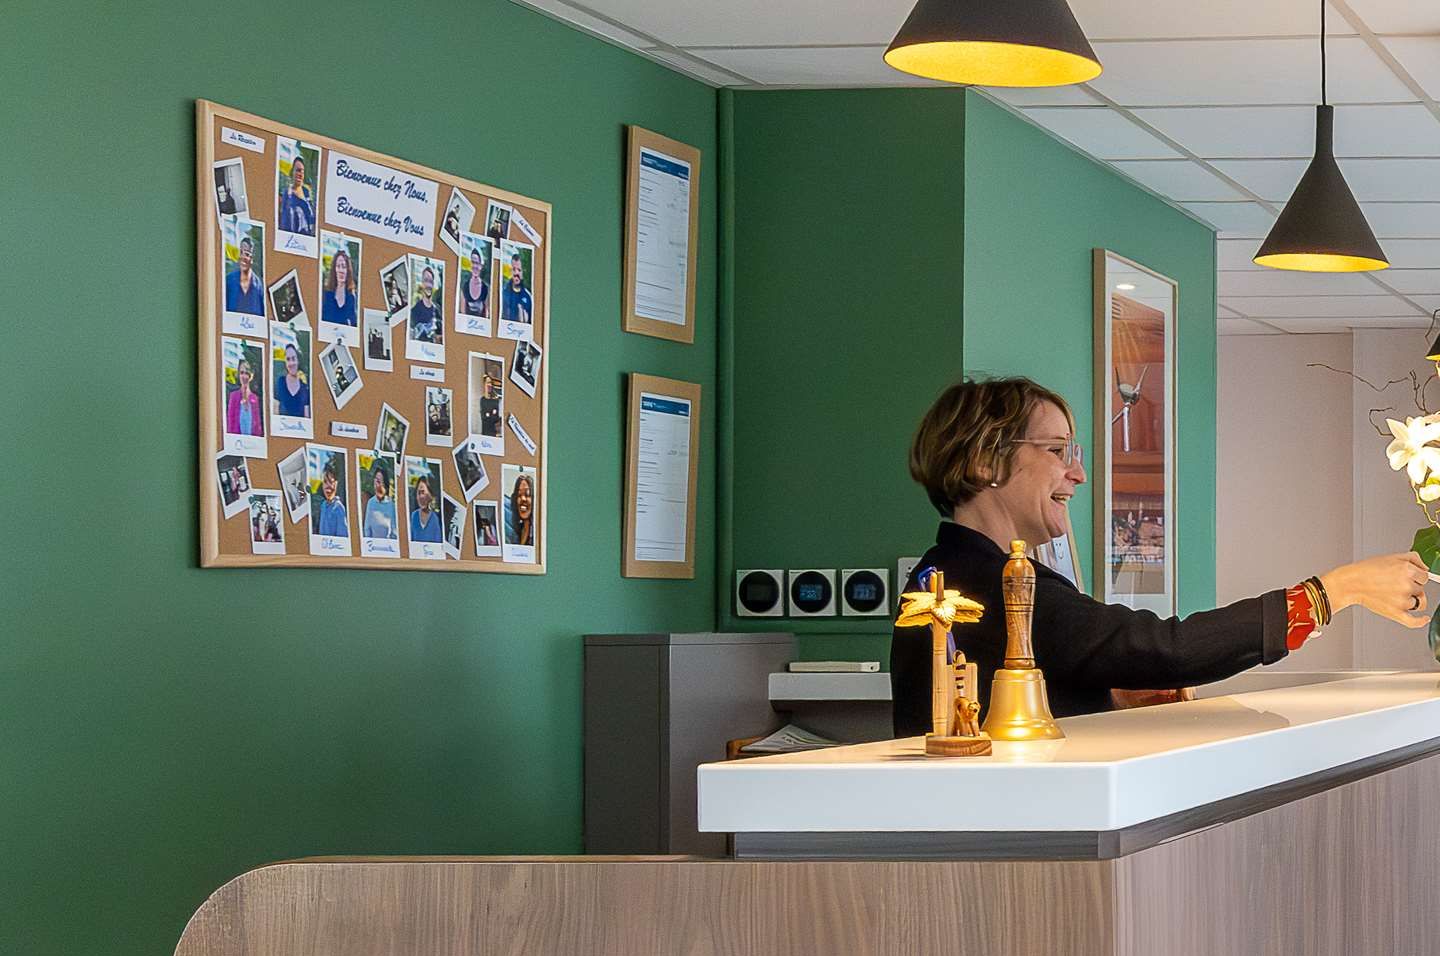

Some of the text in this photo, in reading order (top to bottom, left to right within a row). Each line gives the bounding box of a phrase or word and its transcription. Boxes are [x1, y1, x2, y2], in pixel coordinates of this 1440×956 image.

[336, 159, 382, 188] Bienvenue
[384, 175, 402, 200] chez
[337, 196, 424, 236] Bienvenue chez Vous
